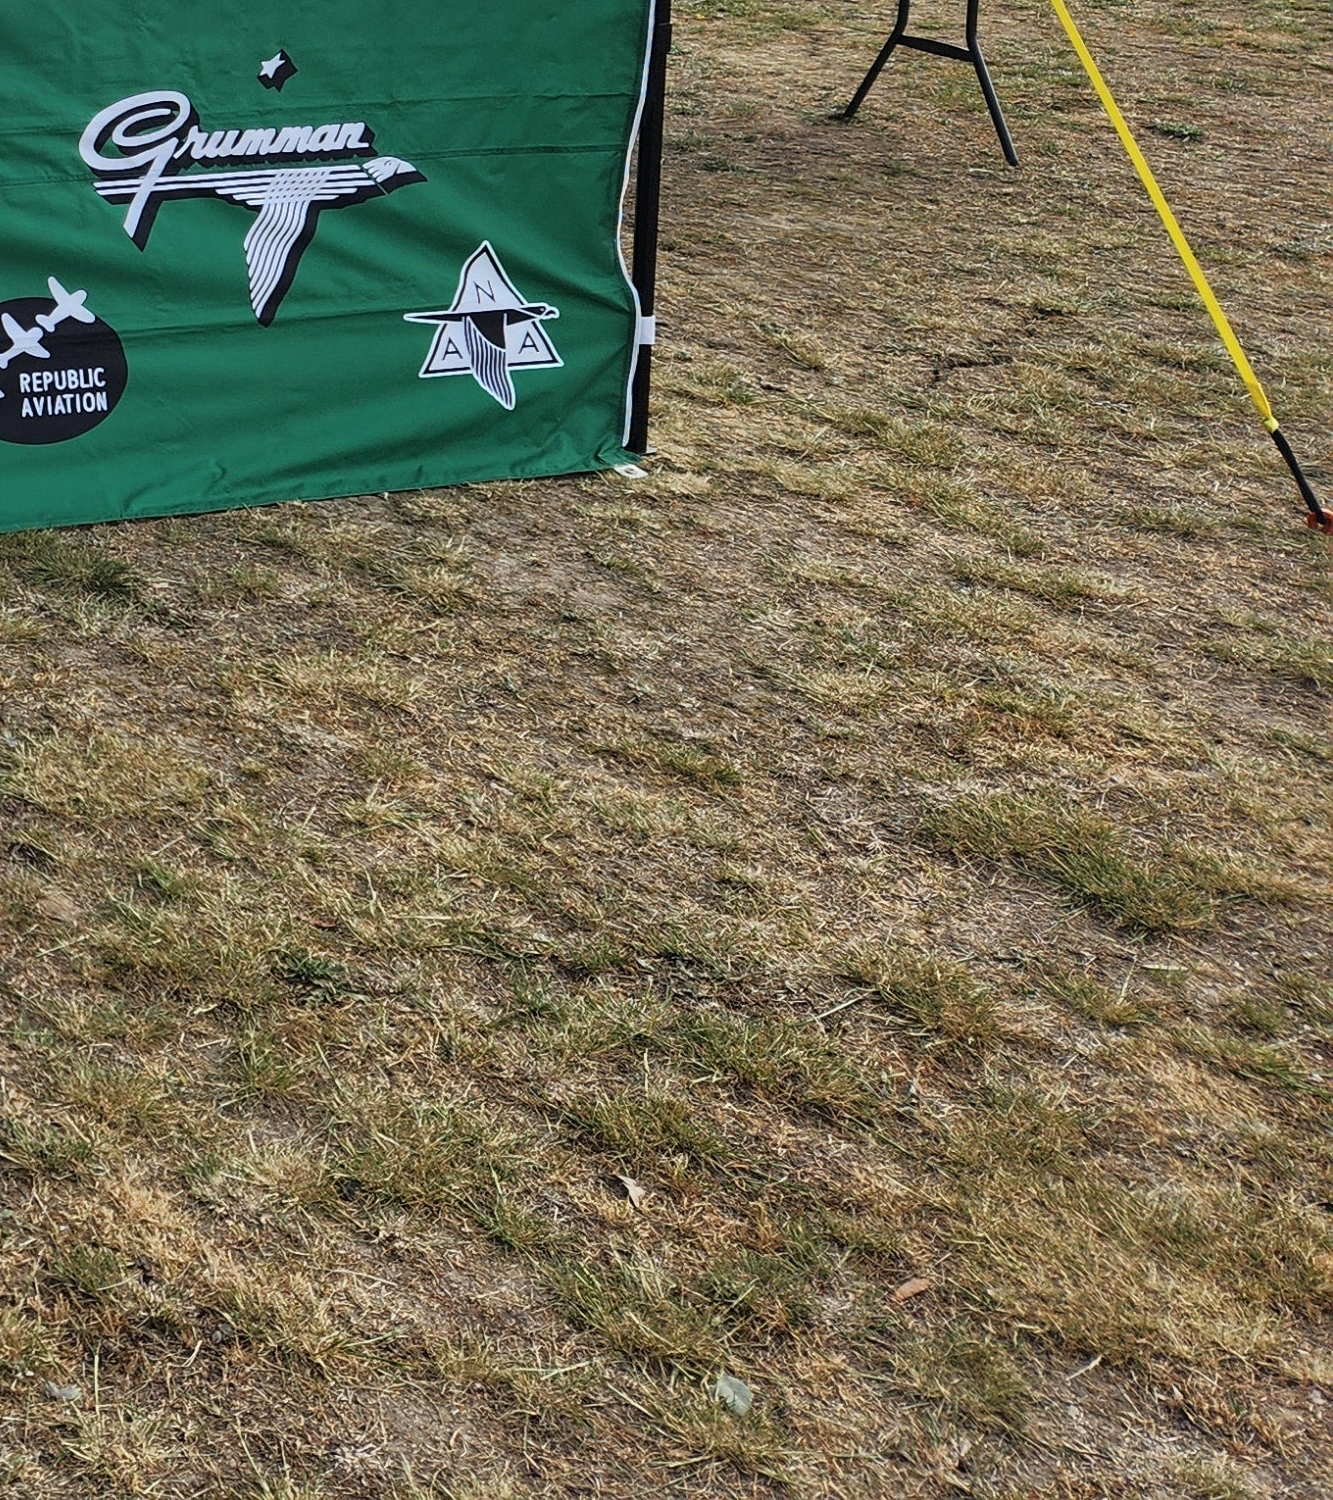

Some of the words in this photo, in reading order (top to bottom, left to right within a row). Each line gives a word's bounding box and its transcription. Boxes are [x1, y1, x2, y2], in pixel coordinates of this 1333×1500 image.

[78, 90, 371, 238] Grumman
[473, 280, 496, 304] N
[442, 337, 463, 361] A
[519, 331, 540, 354] A
[19, 367, 107, 393] REPUBLIC
[21, 391, 108, 418] AVIATION
